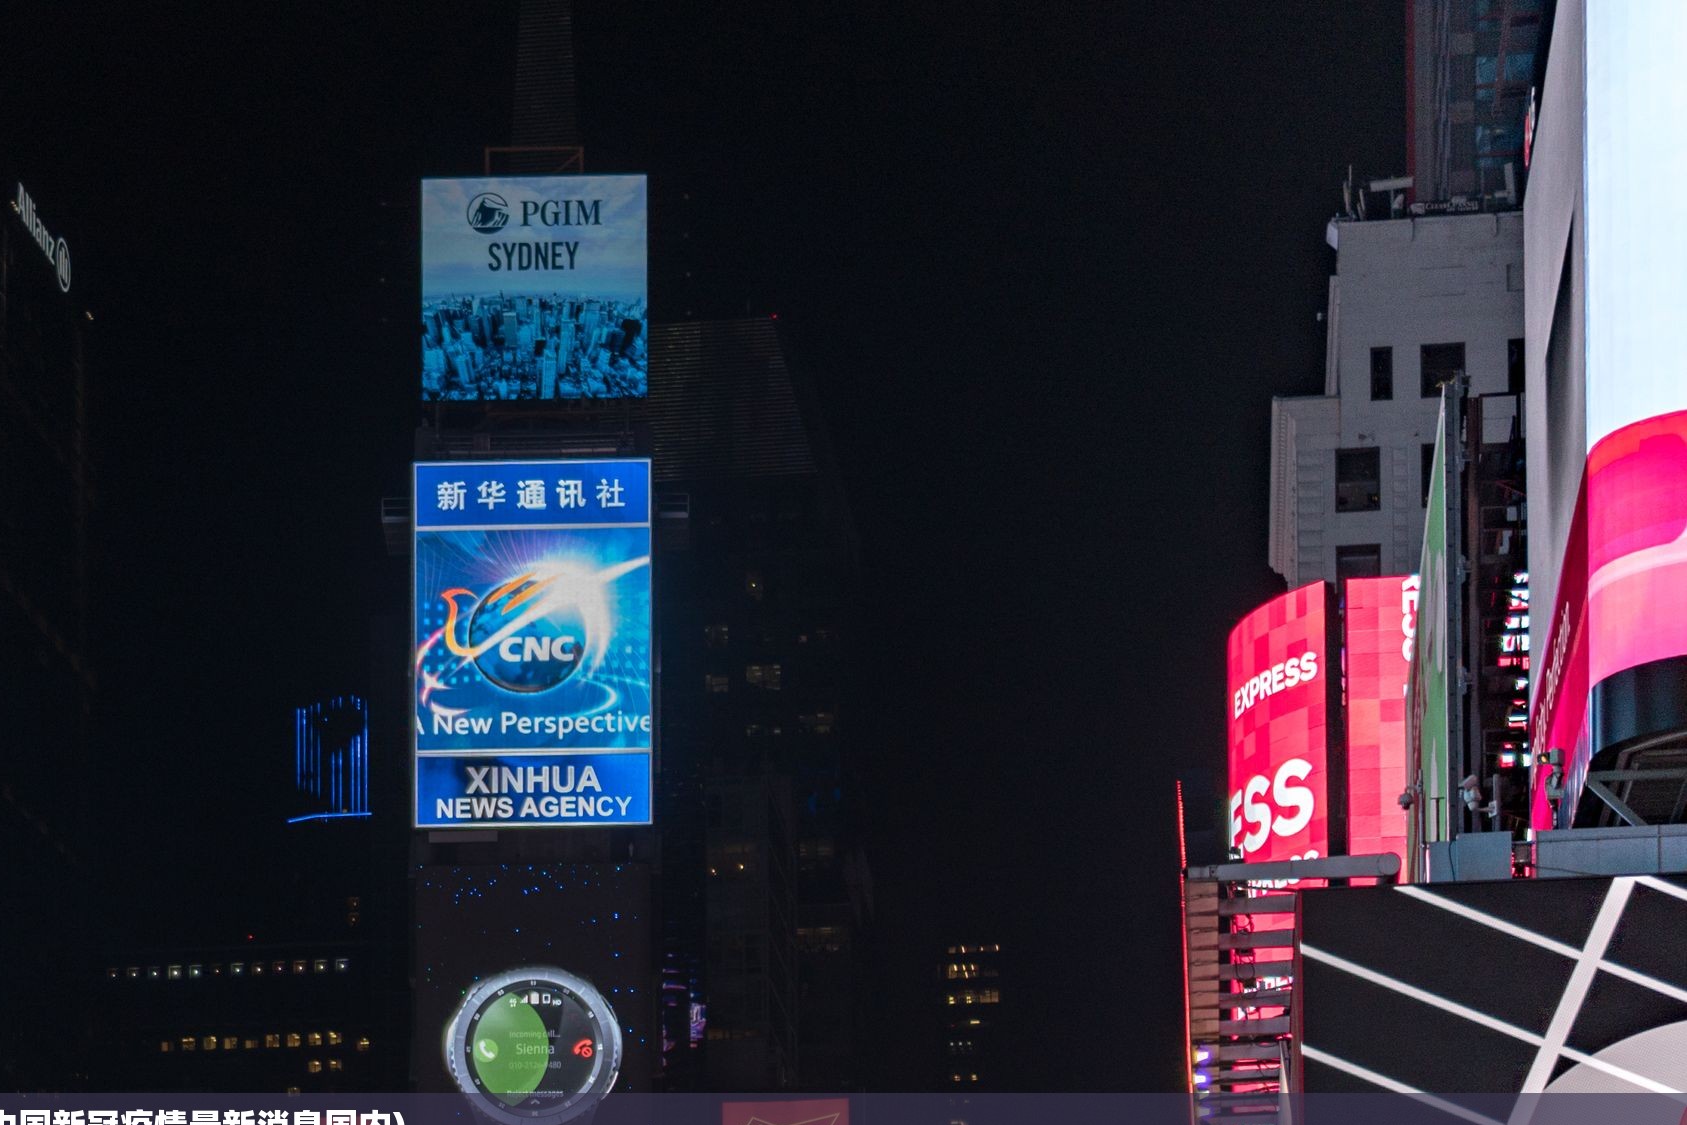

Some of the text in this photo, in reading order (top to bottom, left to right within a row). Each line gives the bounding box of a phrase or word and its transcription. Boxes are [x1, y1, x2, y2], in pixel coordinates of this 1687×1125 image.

[17, 181, 56, 266] Allianz
[520, 199, 603, 228] PGIM
[488, 241, 579, 272] SYDNEY
[436, 479, 626, 512] 新华通讯社
[499, 636, 575, 663] CNC
[1234, 651, 1317, 720] EXPRESS
[433, 712, 650, 739] New Perspective
[466, 765, 602, 795] XINHUA
[436, 796, 632, 819] NEWS AGENCY
[516, 1043, 555, 1055] Sienna
